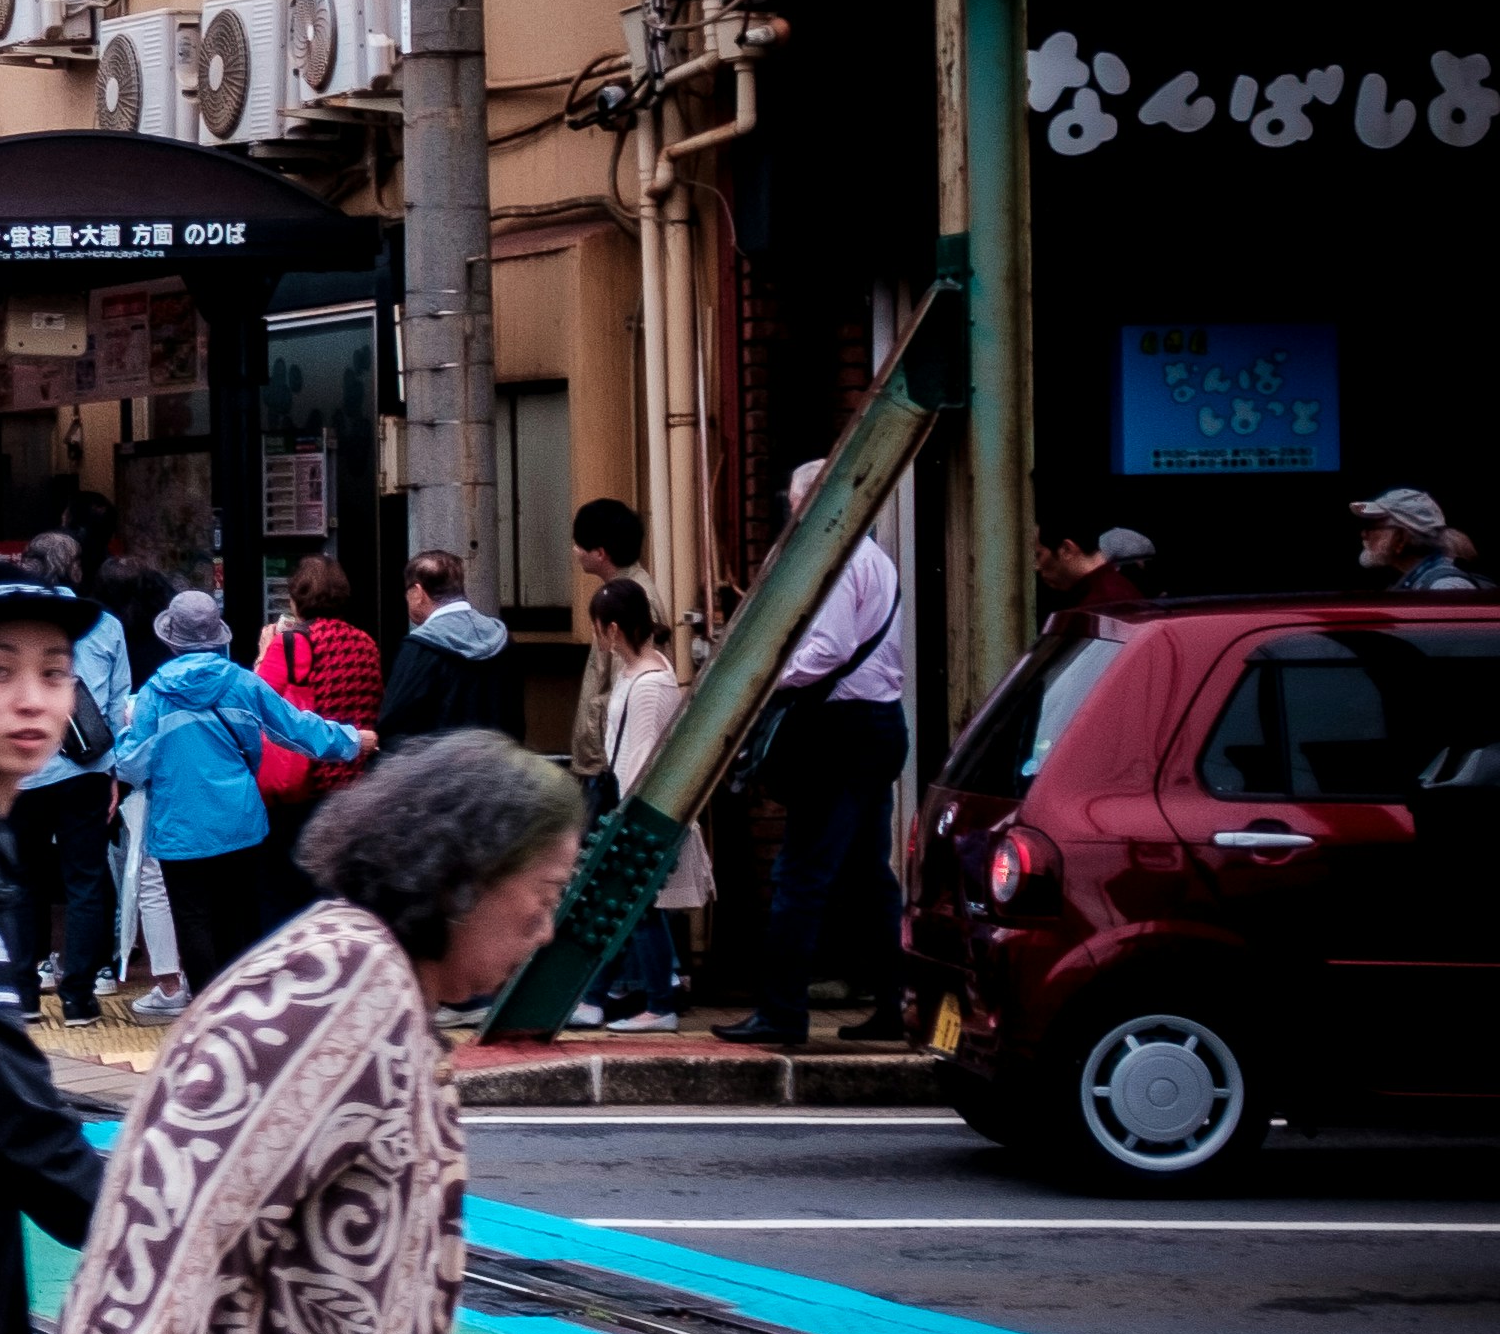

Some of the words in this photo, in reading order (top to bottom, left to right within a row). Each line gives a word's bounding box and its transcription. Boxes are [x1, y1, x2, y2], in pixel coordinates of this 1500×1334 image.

[132, 223, 173, 246] 方面
[184, 223, 246, 245] のりば
